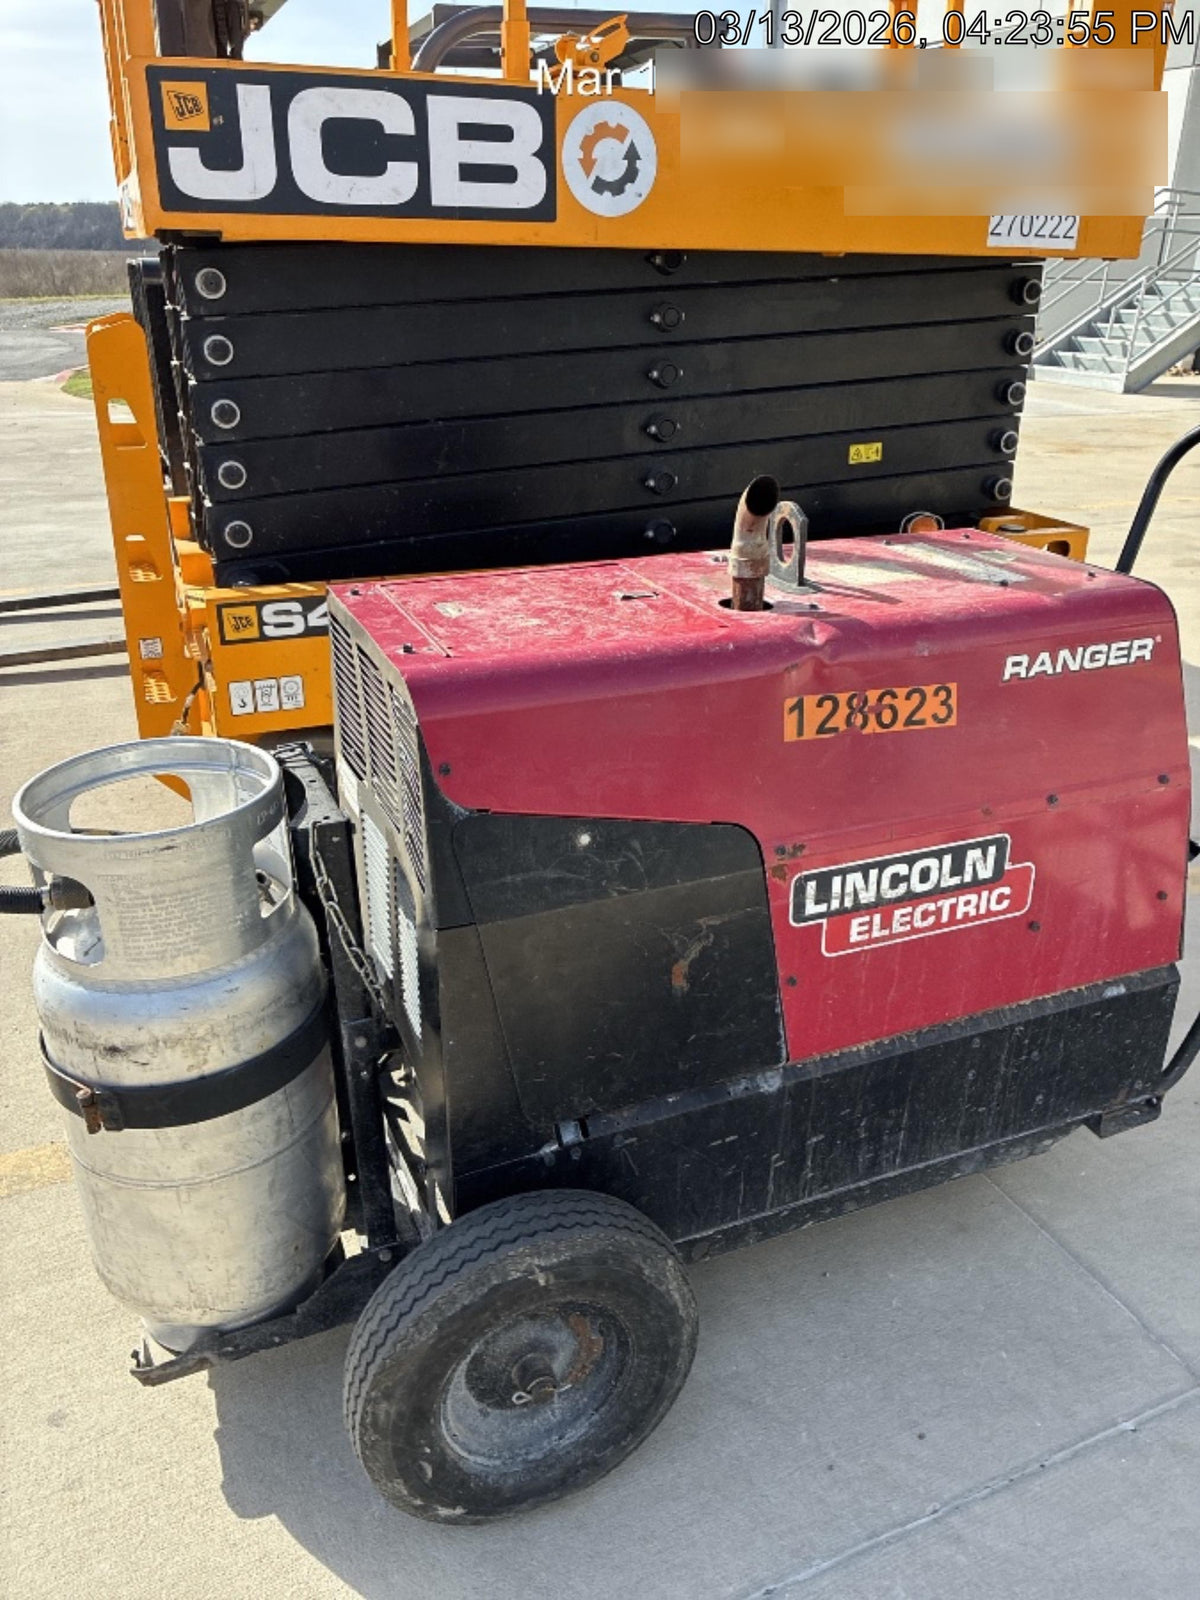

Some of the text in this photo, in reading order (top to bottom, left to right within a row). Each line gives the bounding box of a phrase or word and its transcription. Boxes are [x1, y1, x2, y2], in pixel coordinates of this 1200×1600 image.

[174, 94, 201, 117] JCB
[167, 83, 547, 209] JCB
[1002, 638, 1155, 681] RANGER
[788, 686, 954, 737] 128623
[804, 845, 997, 916] LINCOLN
[849, 887, 1012, 943] ELECTRIC
